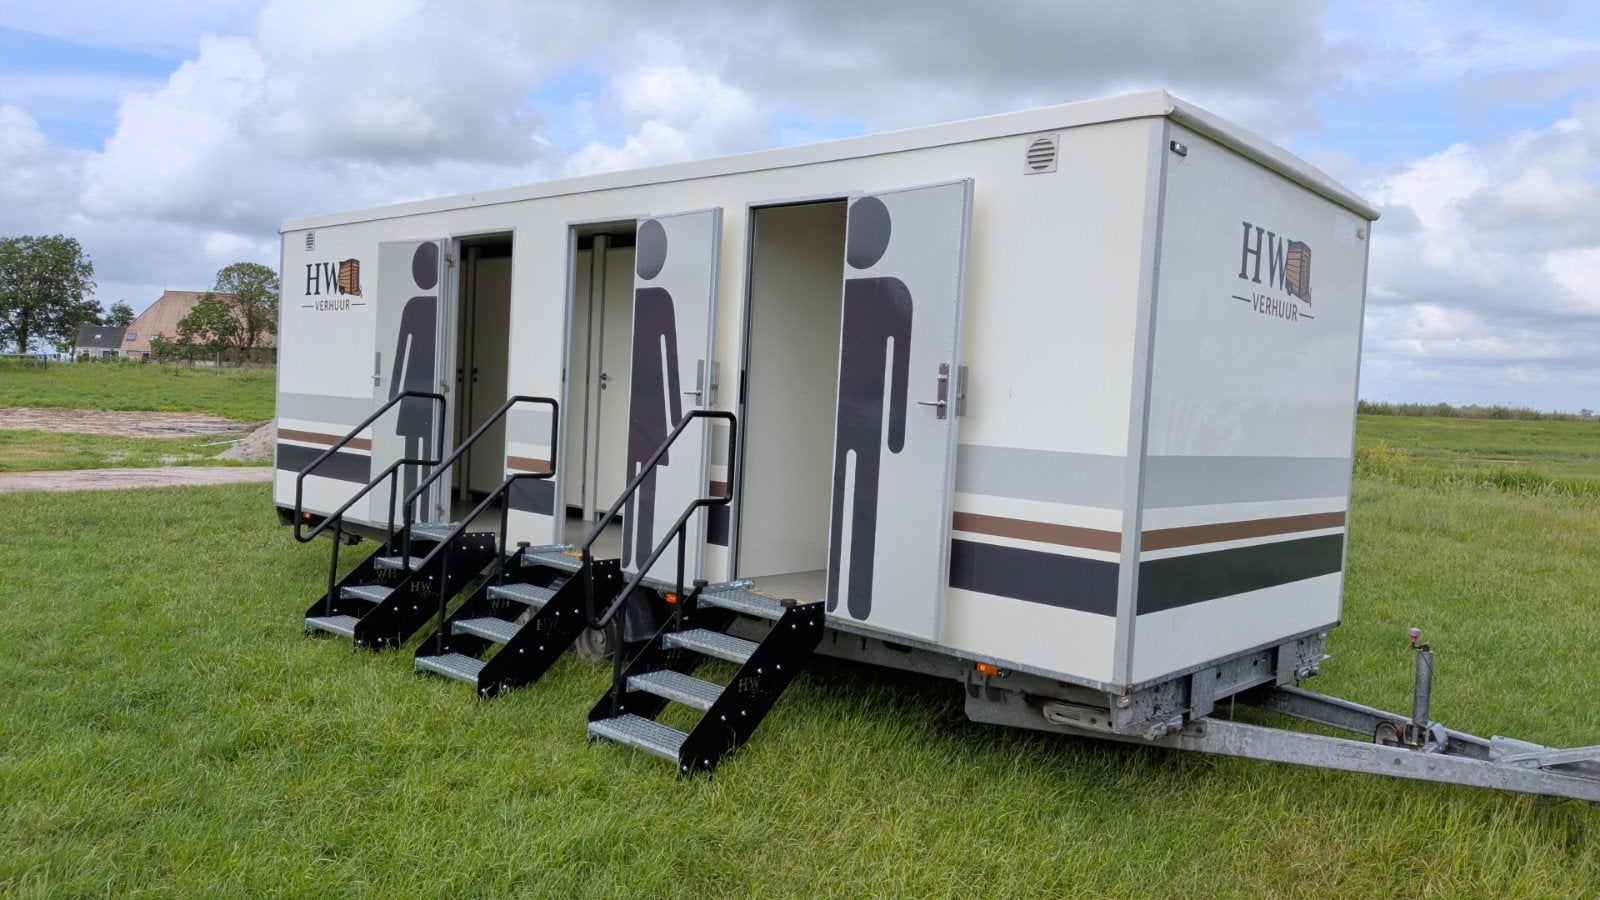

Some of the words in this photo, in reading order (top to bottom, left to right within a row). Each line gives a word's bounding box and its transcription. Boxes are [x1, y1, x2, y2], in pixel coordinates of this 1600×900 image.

[1239, 221, 1292, 291] HW
[305, 262, 343, 295] HW
[315, 300, 350, 311] VERHUUR
[1253, 292, 1298, 321] VERHUUR
